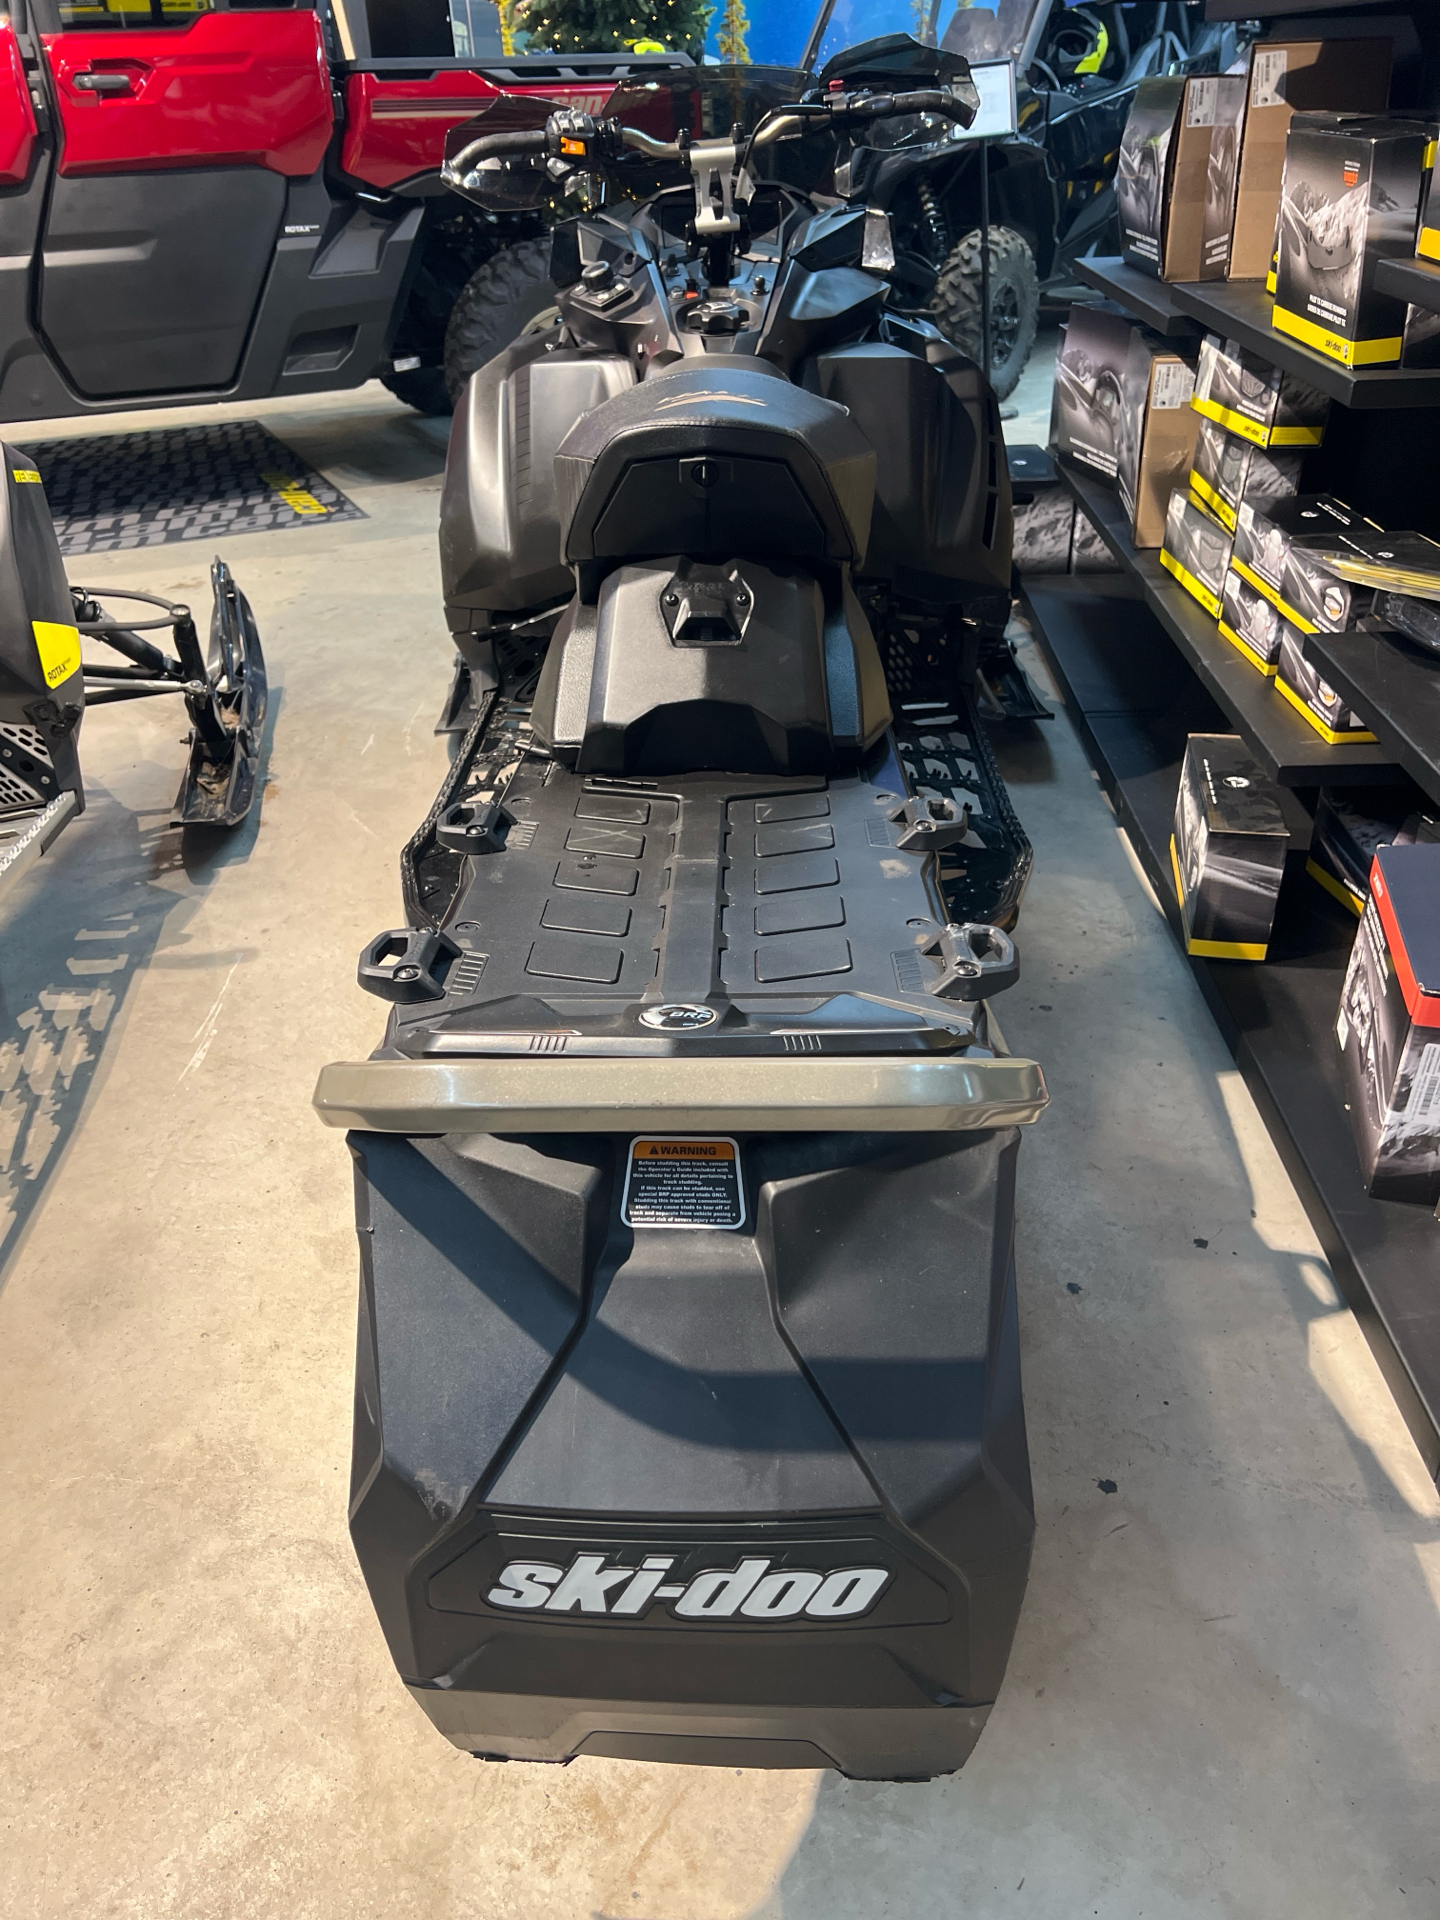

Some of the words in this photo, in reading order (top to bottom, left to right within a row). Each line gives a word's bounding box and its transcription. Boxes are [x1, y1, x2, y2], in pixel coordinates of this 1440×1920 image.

[1325, 339, 1341, 353] ski-doo
[47, 662, 67, 682] ROTAX
[660, 1146, 717, 1155] WARNING
[488, 1556, 888, 1617] ski-doo
